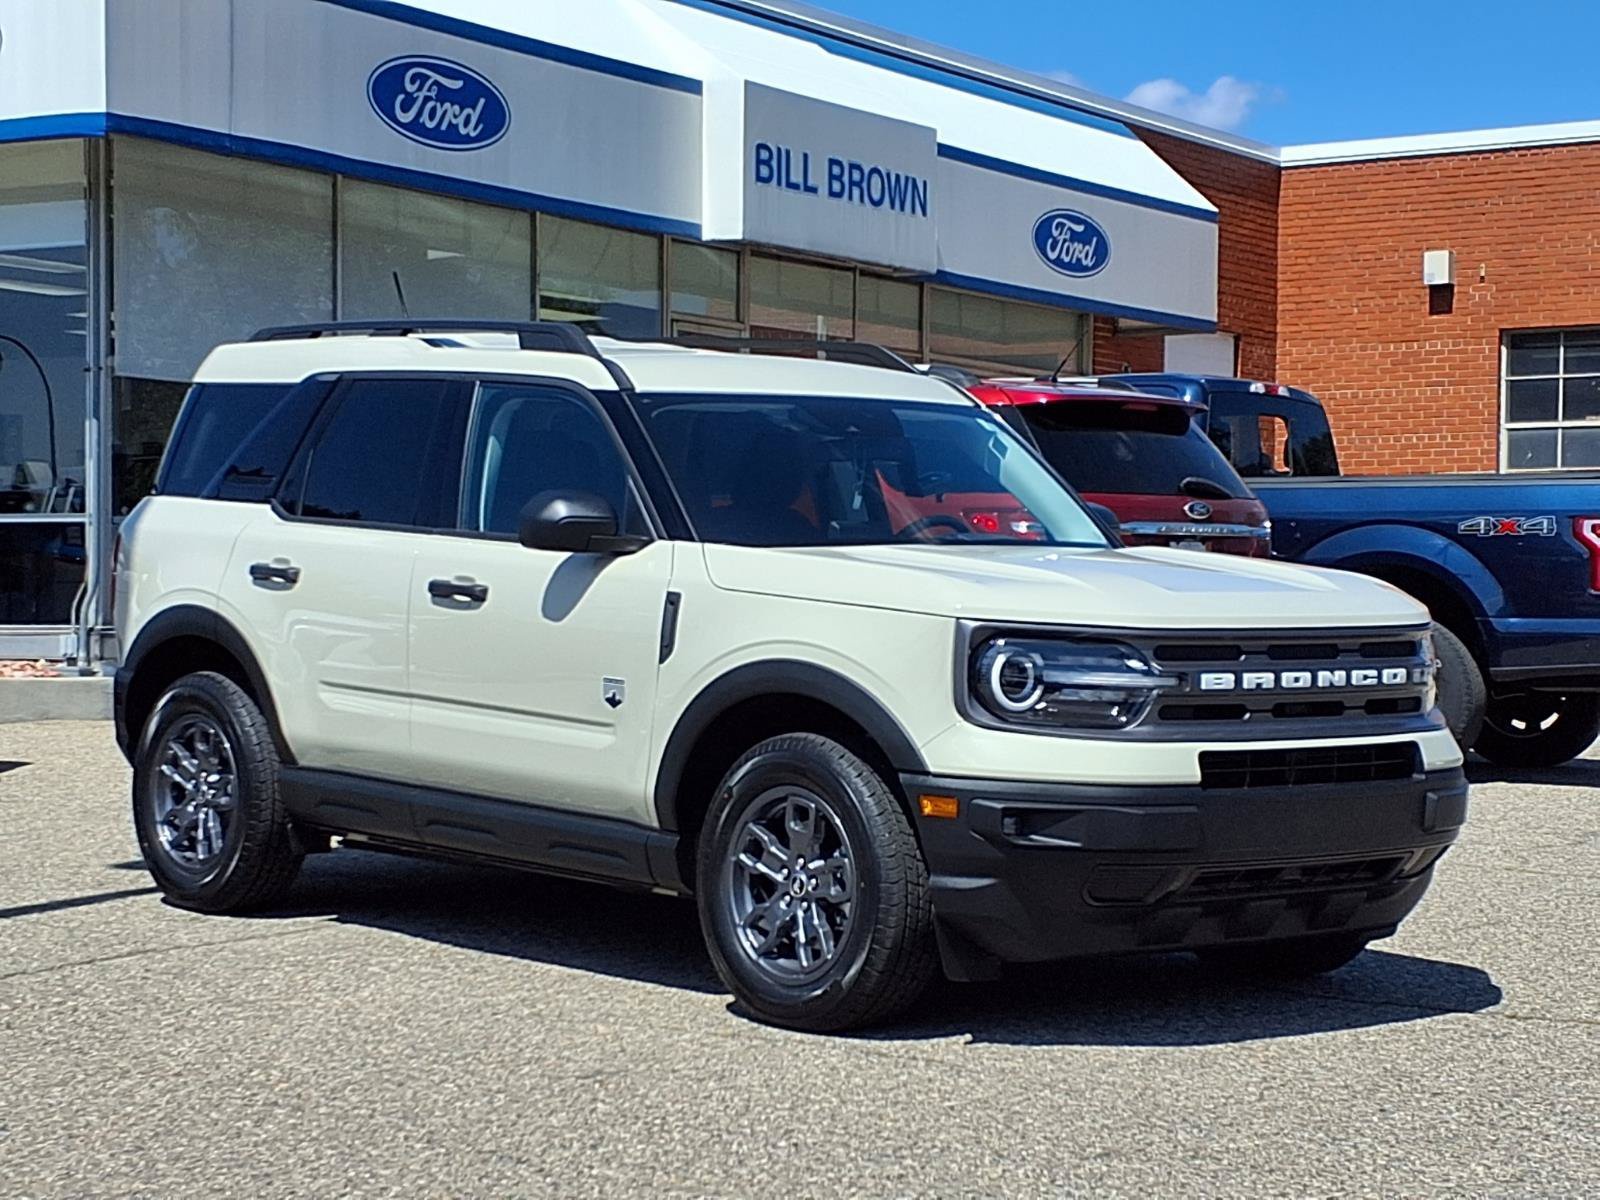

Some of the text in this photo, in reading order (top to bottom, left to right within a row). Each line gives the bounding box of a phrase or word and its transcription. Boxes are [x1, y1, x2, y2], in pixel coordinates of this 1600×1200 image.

[394, 67, 486, 137] Ford
[755, 143, 928, 217] BILL BROWN
[1046, 217, 1098, 267] Ford
[1199, 667, 1408, 691] BRONCO
